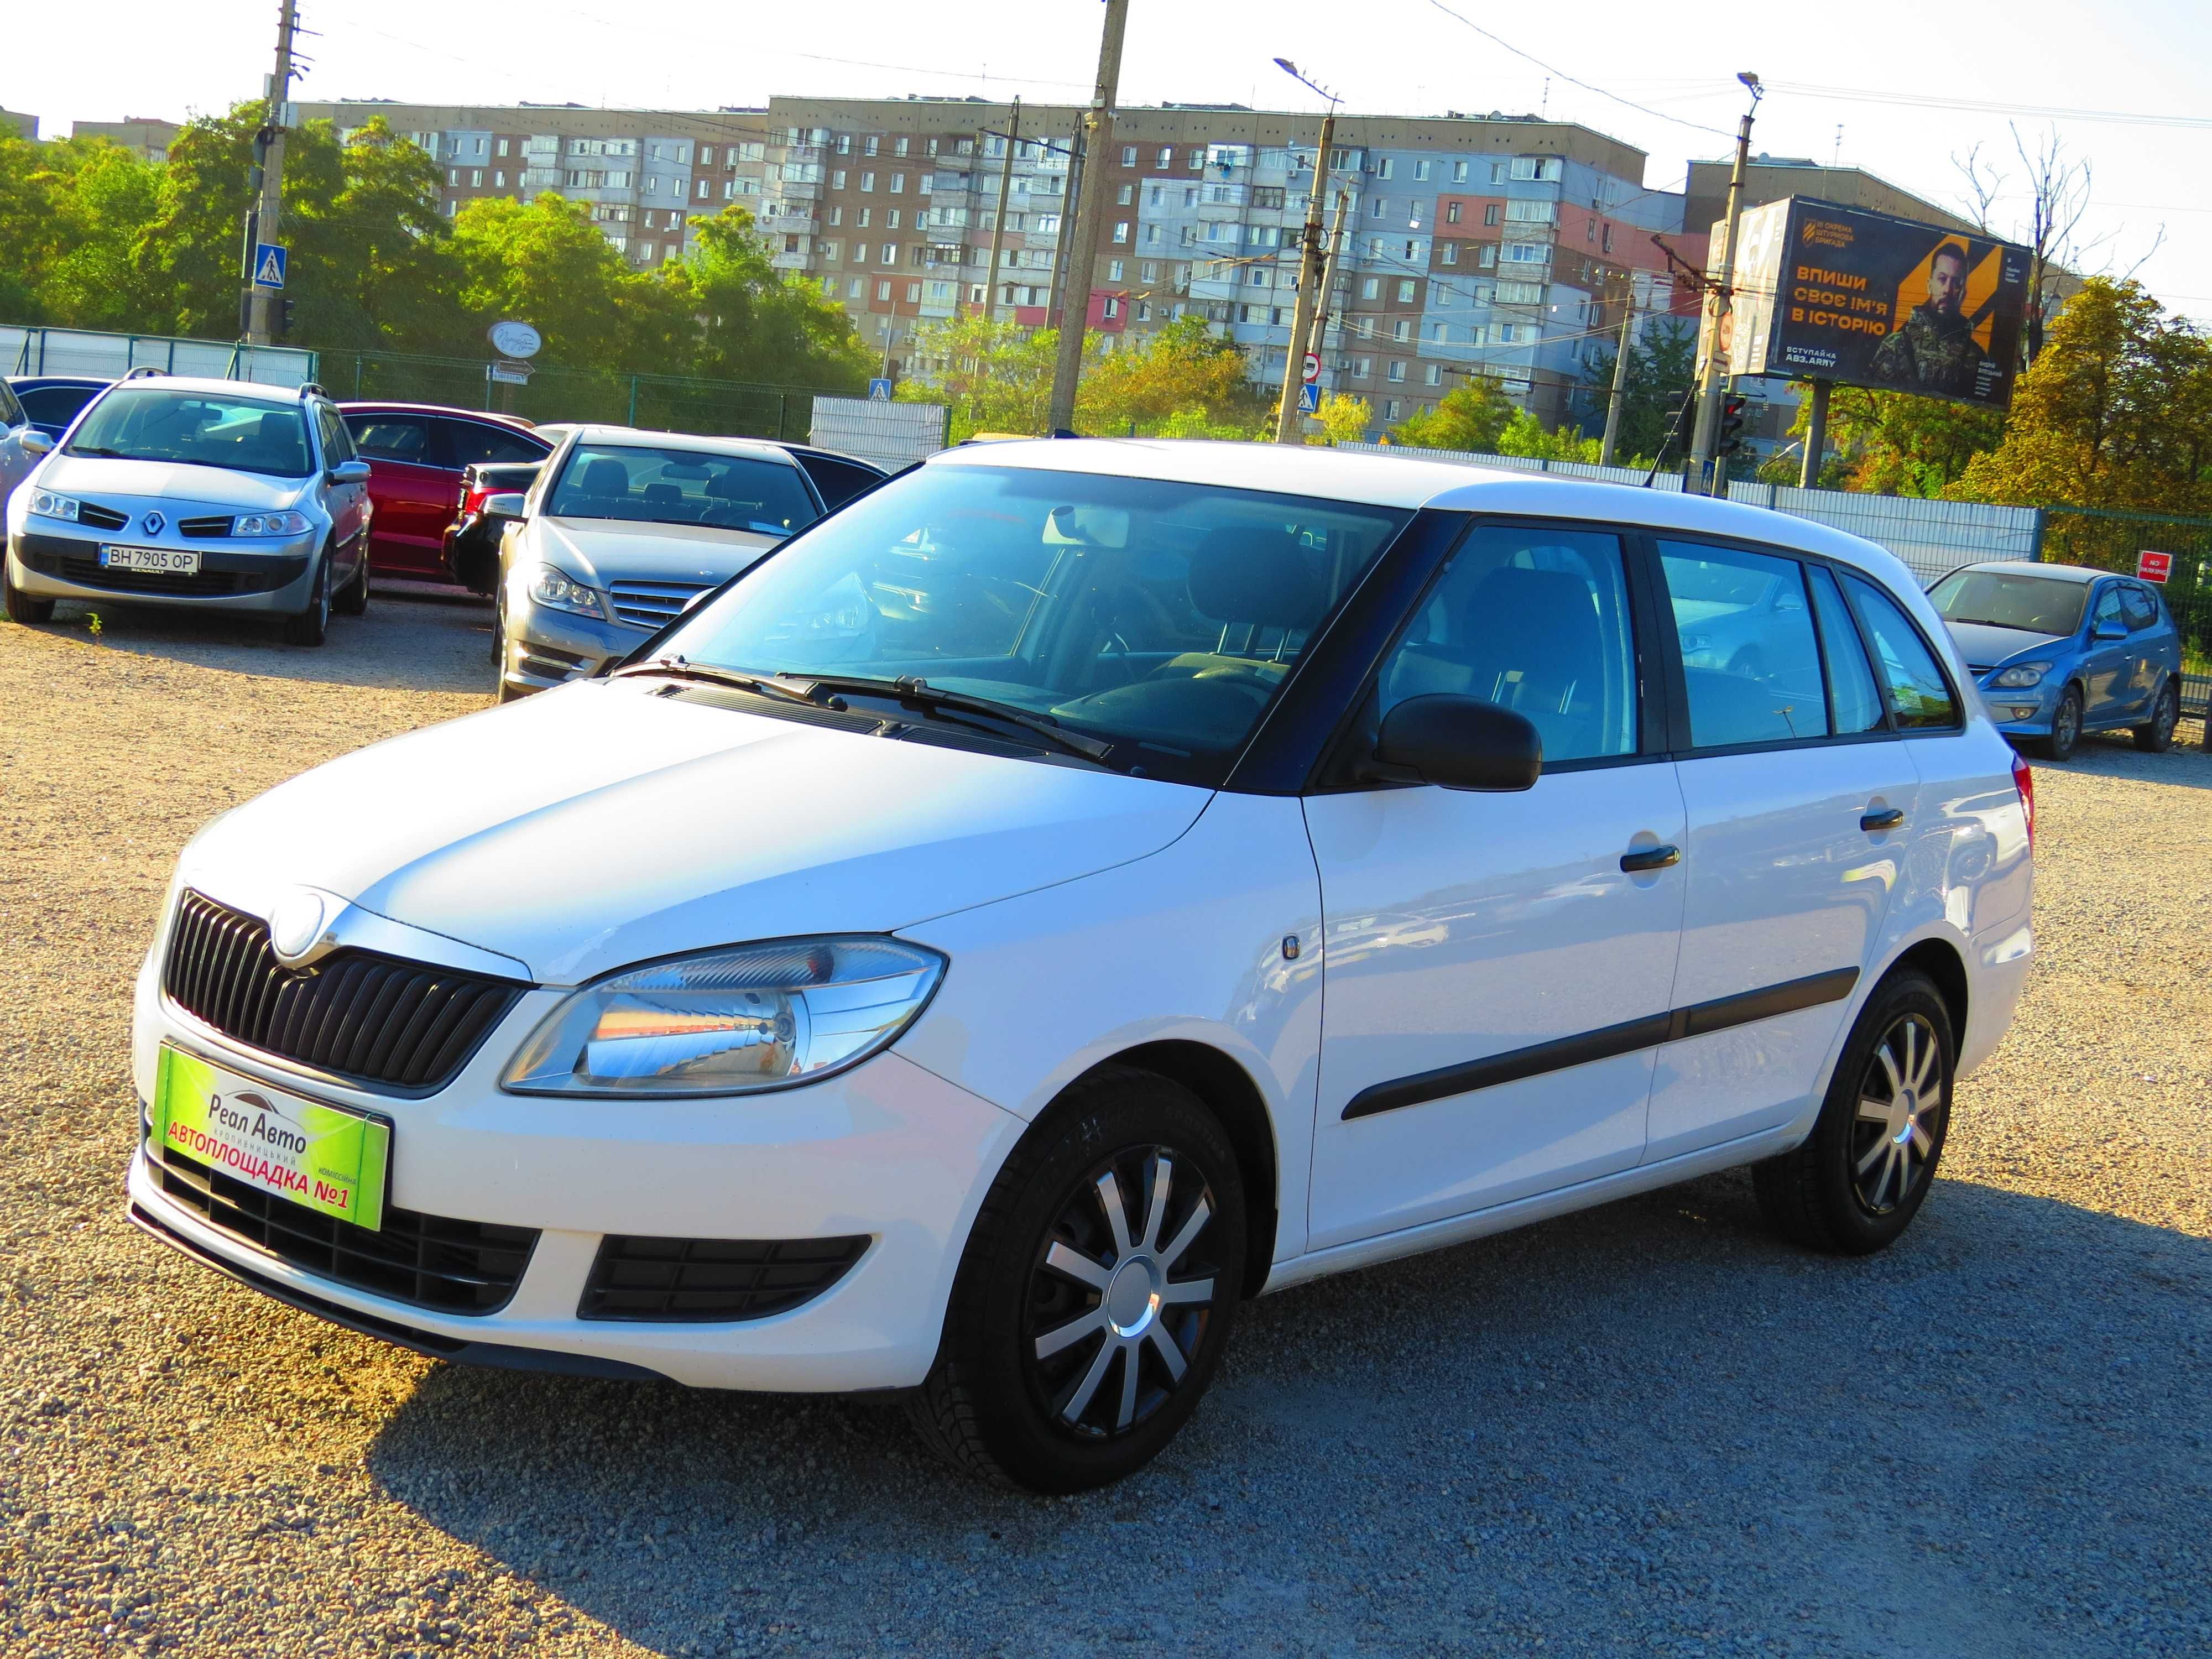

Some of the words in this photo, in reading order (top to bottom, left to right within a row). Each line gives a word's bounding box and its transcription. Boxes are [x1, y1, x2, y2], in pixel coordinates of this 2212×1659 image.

[1797, 265, 1867, 291] ВПИШИ
[1794, 287, 1846, 307] СВОЄ
[1850, 296, 1888, 316] ІМ'Я
[1791, 307, 1804, 322] В
[1808, 310, 1886, 336] ІСТОРІЮ
[111, 549, 132, 565] BH
[135, 551, 168, 567] 7905
[173, 555, 194, 569] OP
[2141, 567, 2168, 576] PARKING
[208, 1094, 249, 1133] Реал
[251, 1113, 307, 1154] Авто
[214, 1128, 296, 1167] КРОПИВНИЦЬКИЙ
[168, 1121, 308, 1195] АВТОПЛОЩАДКА
[314, 1180, 350, 1209] №1
